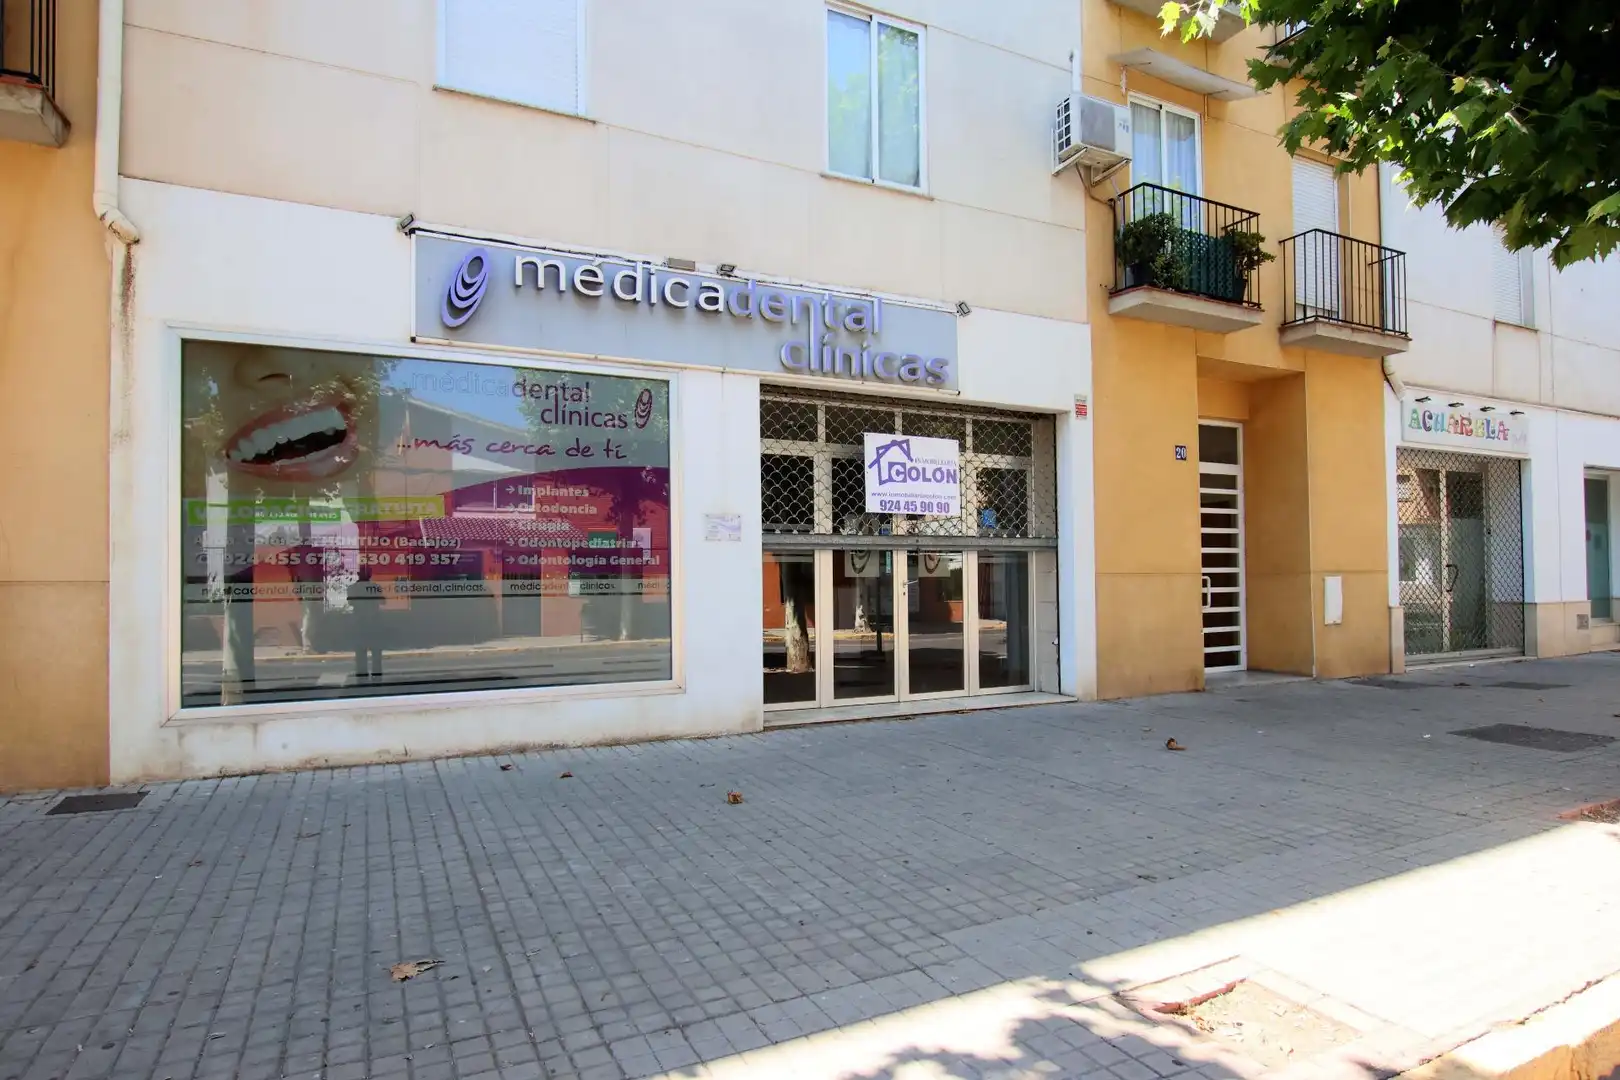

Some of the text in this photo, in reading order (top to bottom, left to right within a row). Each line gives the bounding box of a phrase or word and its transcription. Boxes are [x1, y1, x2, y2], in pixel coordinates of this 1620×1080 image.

[513, 253, 884, 334] médicadental
[540, 400, 628, 429] clínicas
[1408, 406, 1510, 441] ACUARELA
[486, 440, 556, 456] cerca
[565, 437, 595, 458] de
[1175, 446, 1187, 459] 20
[517, 484, 590, 499] Implantes
[517, 503, 598, 514] Ortodoncia
[879, 499, 950, 514] 924 45 90 90
[393, 535, 461, 548] (Badajoz)
[265, 553, 302, 565] 455
[395, 554, 426, 565] 419
[430, 554, 461, 565] 357
[517, 554, 660, 567] Odontología General
